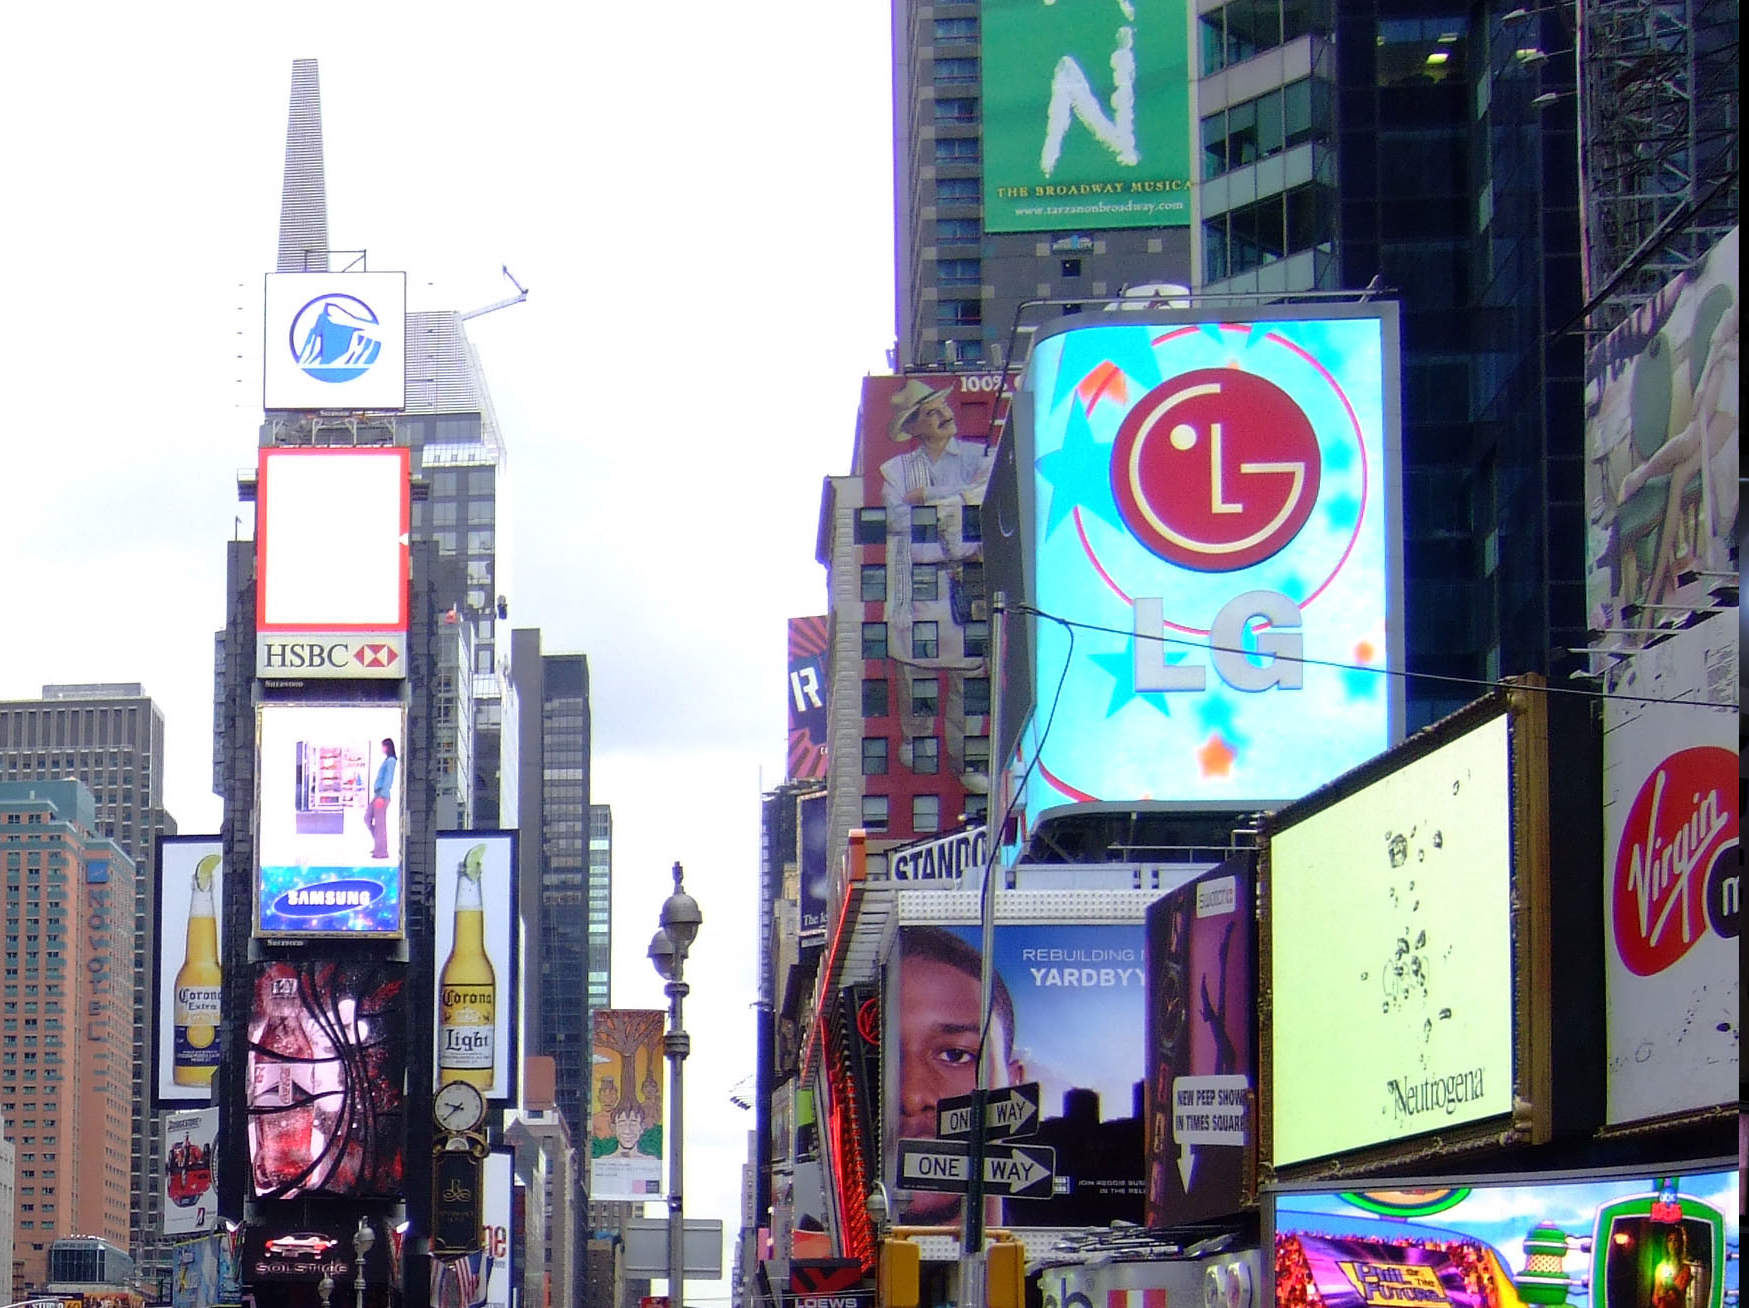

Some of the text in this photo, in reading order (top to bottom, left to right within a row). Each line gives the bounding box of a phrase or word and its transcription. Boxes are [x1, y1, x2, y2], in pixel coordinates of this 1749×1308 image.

[997, 187, 1028, 198] THE
[1036, 183, 1124, 197] BROADWAY
[1015, 200, 1184, 217] www.tarzanonbroadway.com
[960, 376, 1009, 393] 100%
[1133, 590, 1304, 693] LG
[263, 642, 349, 668] HSBC
[1627, 769, 1728, 948] Virgin
[287, 890, 371, 908] SAMSUNG
[1022, 949, 1134, 961] REBUILDING
[442, 987, 493, 1006] Corona
[188, 1001, 217, 1011] Extra
[444, 1027, 491, 1052] Light
[1177, 1089, 1193, 1107] NEW
[1196, 1089, 1216, 1106] PEEP
[1393, 1066, 1486, 1119] Neutrogena
[949, 1100, 1027, 1132] ON WAY
[1176, 1114, 1185, 1131] IN
[1186, 1113, 1210, 1131] TIMES
[918, 1156, 1034, 1182] ONE WAY
[794, 1297, 857, 1308] LOEWS
